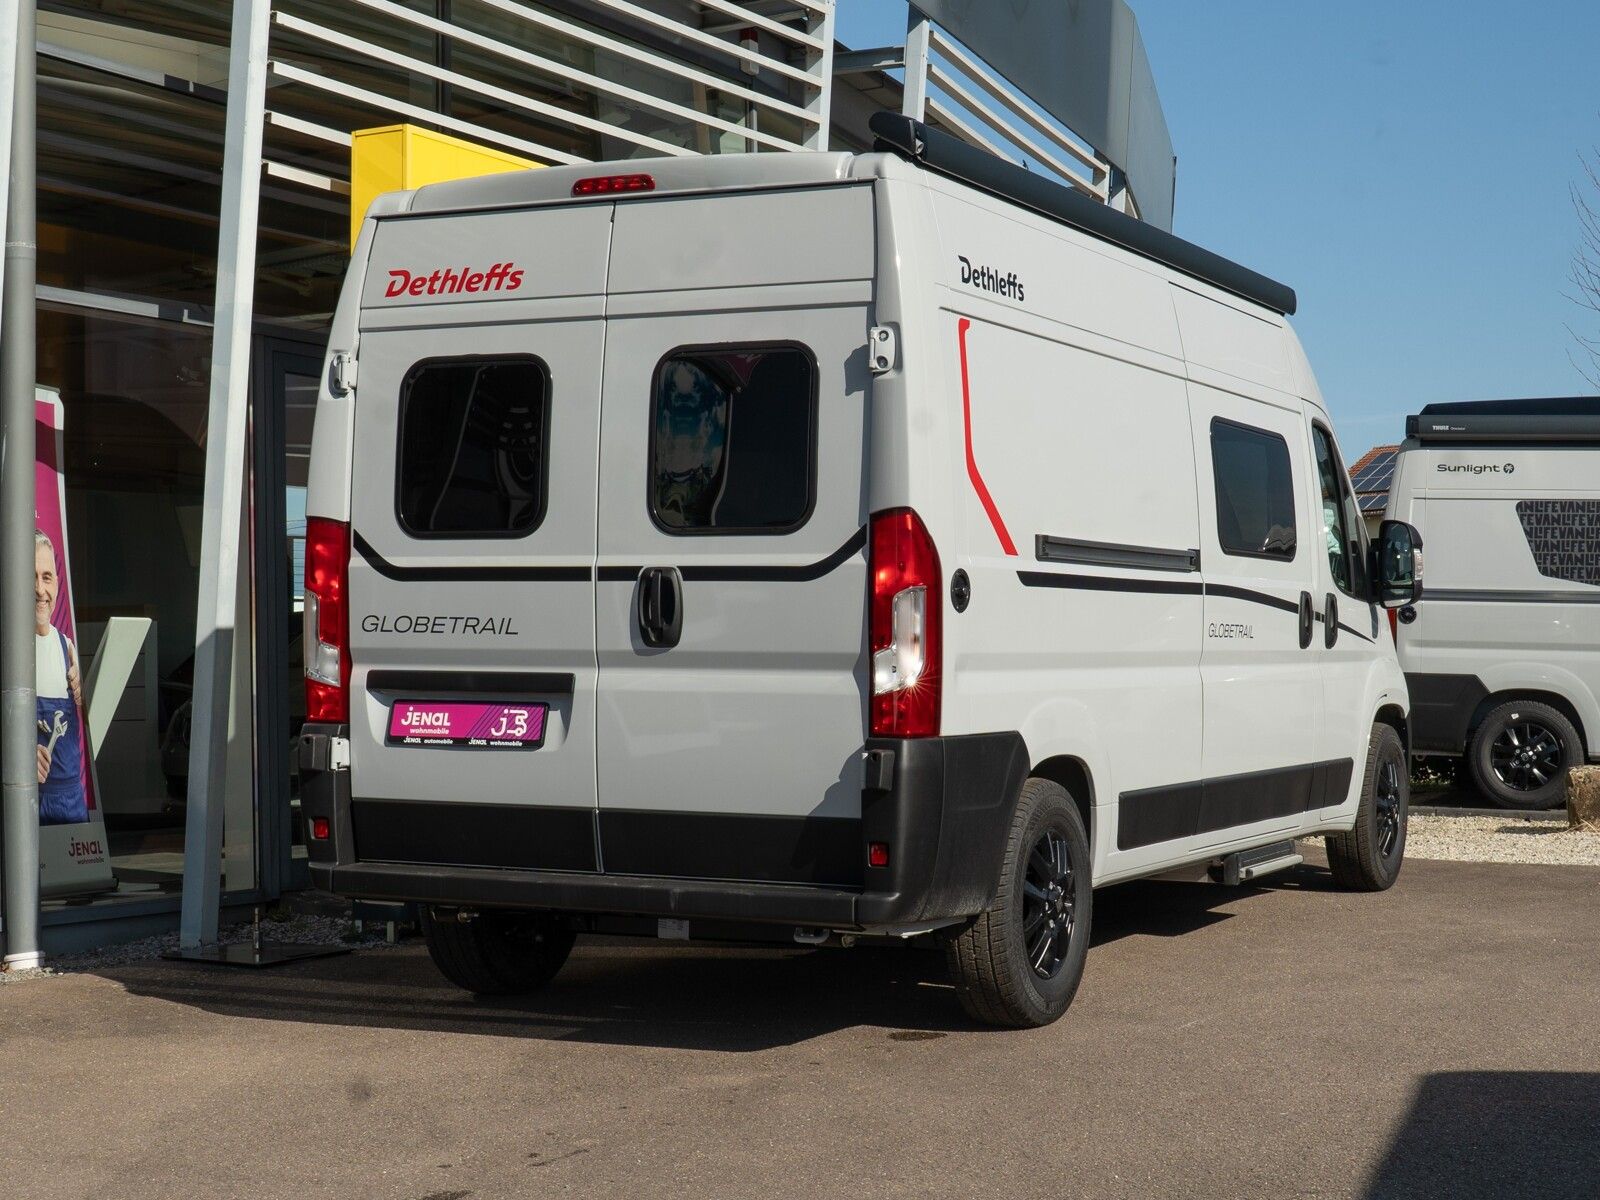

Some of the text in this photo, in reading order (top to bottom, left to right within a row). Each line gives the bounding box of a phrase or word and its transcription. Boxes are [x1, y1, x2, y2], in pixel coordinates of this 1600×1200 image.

[384, 262, 525, 298] Dethleffs
[958, 255, 1024, 301] Dethleffs
[1437, 464, 1500, 475] Sunlight
[361, 615, 519, 635] GLOBETRAIL
[1209, 622, 1254, 639] GLOBETRAIL
[410, 727, 450, 735] wohnmobile
